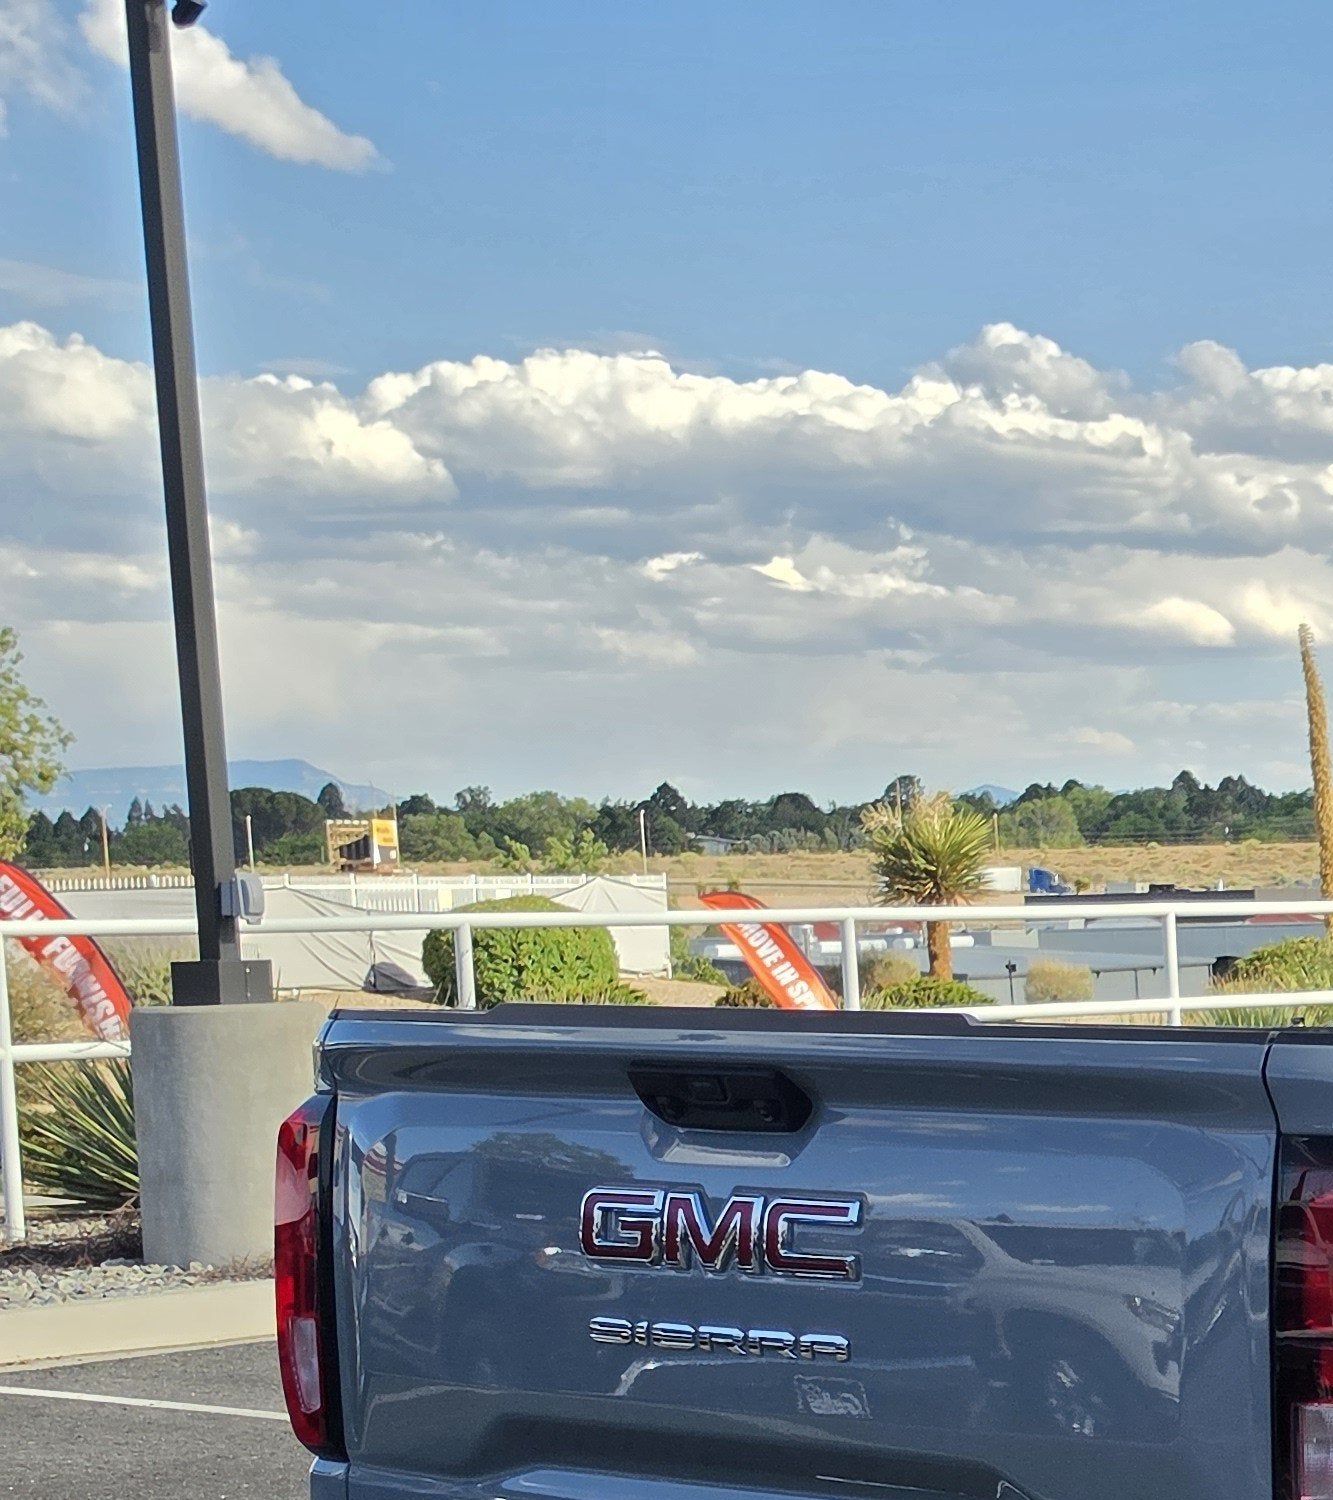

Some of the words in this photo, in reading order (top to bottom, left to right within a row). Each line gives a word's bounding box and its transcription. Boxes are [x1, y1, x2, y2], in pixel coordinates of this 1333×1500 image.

[0, 874, 49, 922] FUL
[771, 961, 799, 987] IN
[579, 1186, 863, 1280] GMC
[589, 1316, 851, 1362] SIERRA
